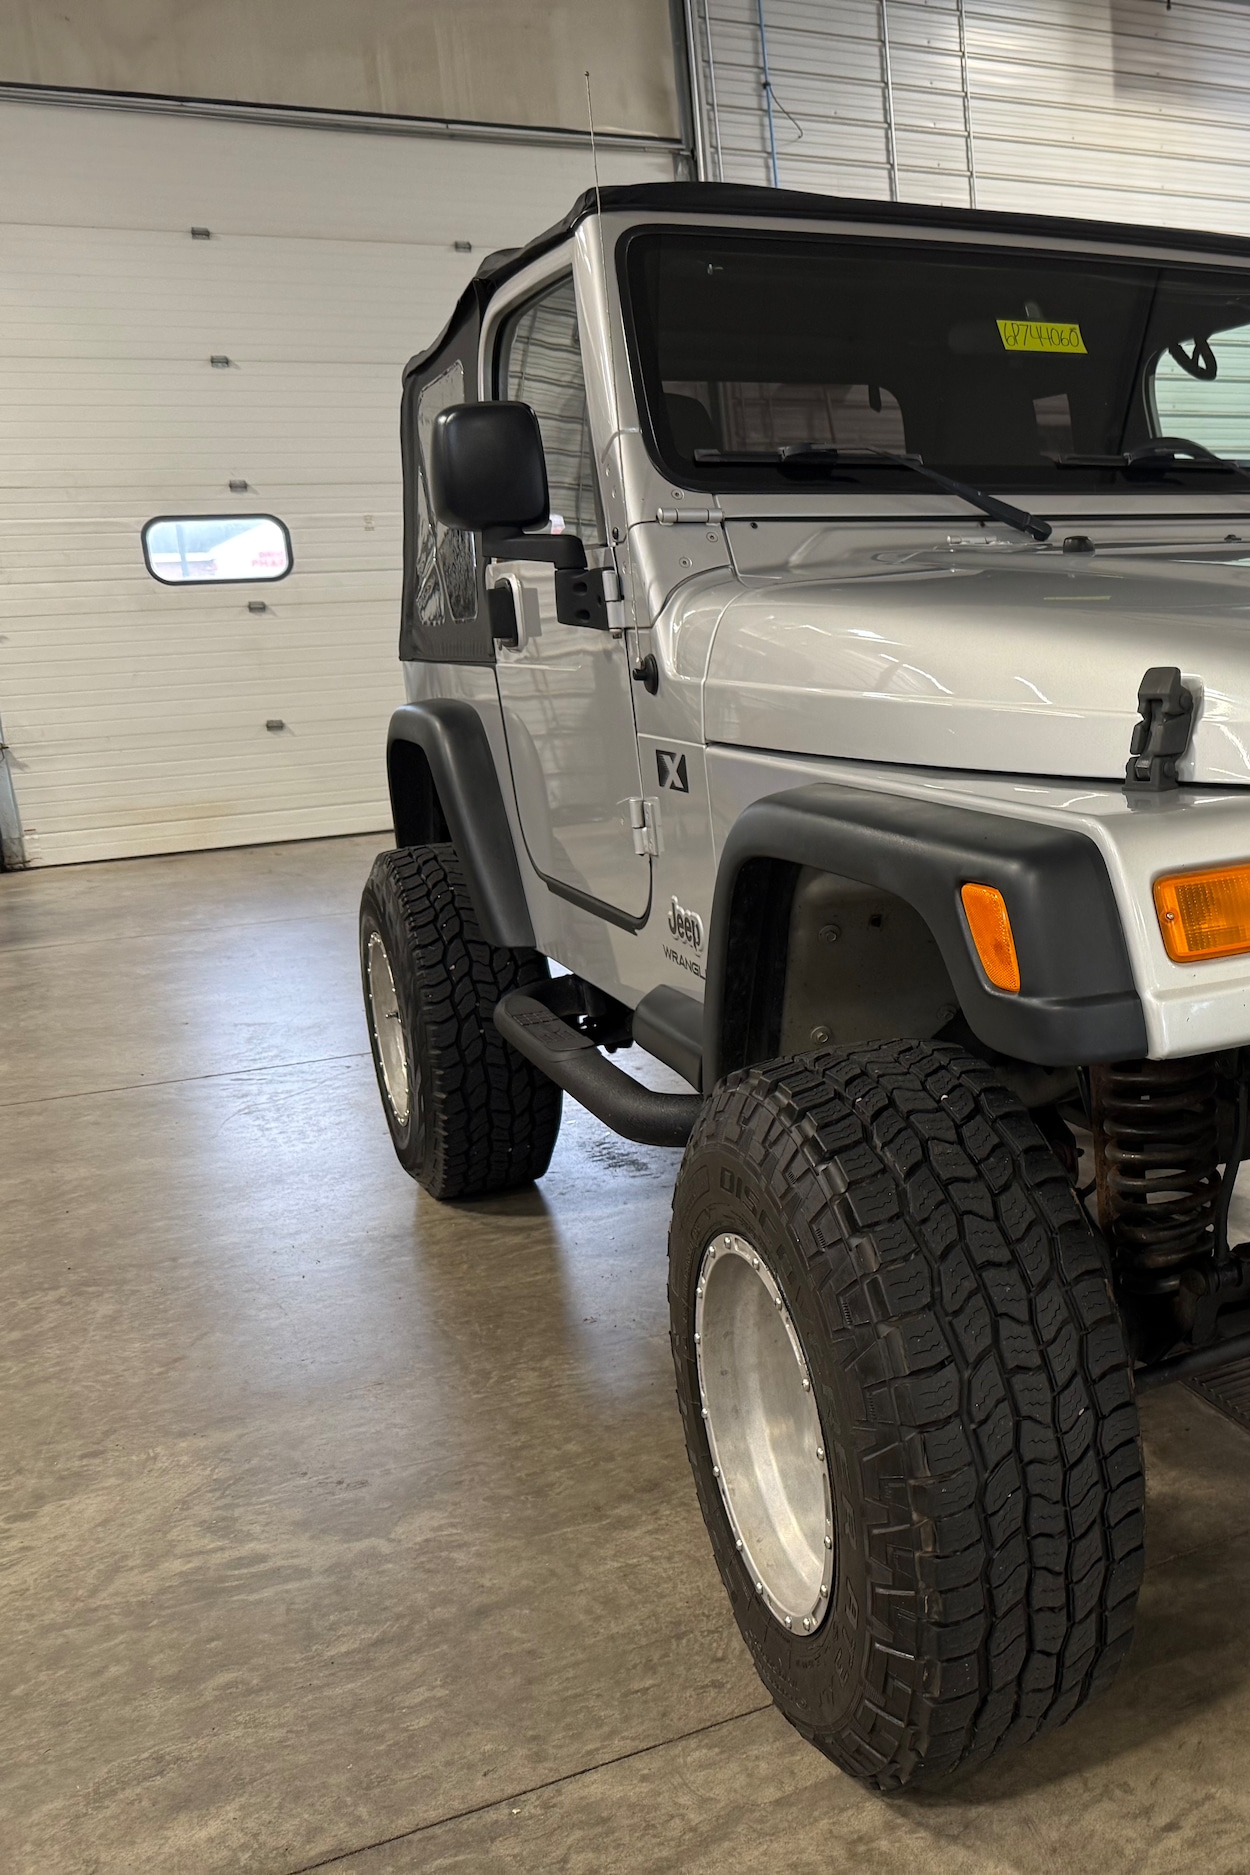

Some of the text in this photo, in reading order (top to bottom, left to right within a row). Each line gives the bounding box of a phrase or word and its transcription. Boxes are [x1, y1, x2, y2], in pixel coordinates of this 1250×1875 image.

[656, 749, 689, 794] X
[668, 898, 703, 954] Jeep
[662, 944, 706, 980] WRANGL
